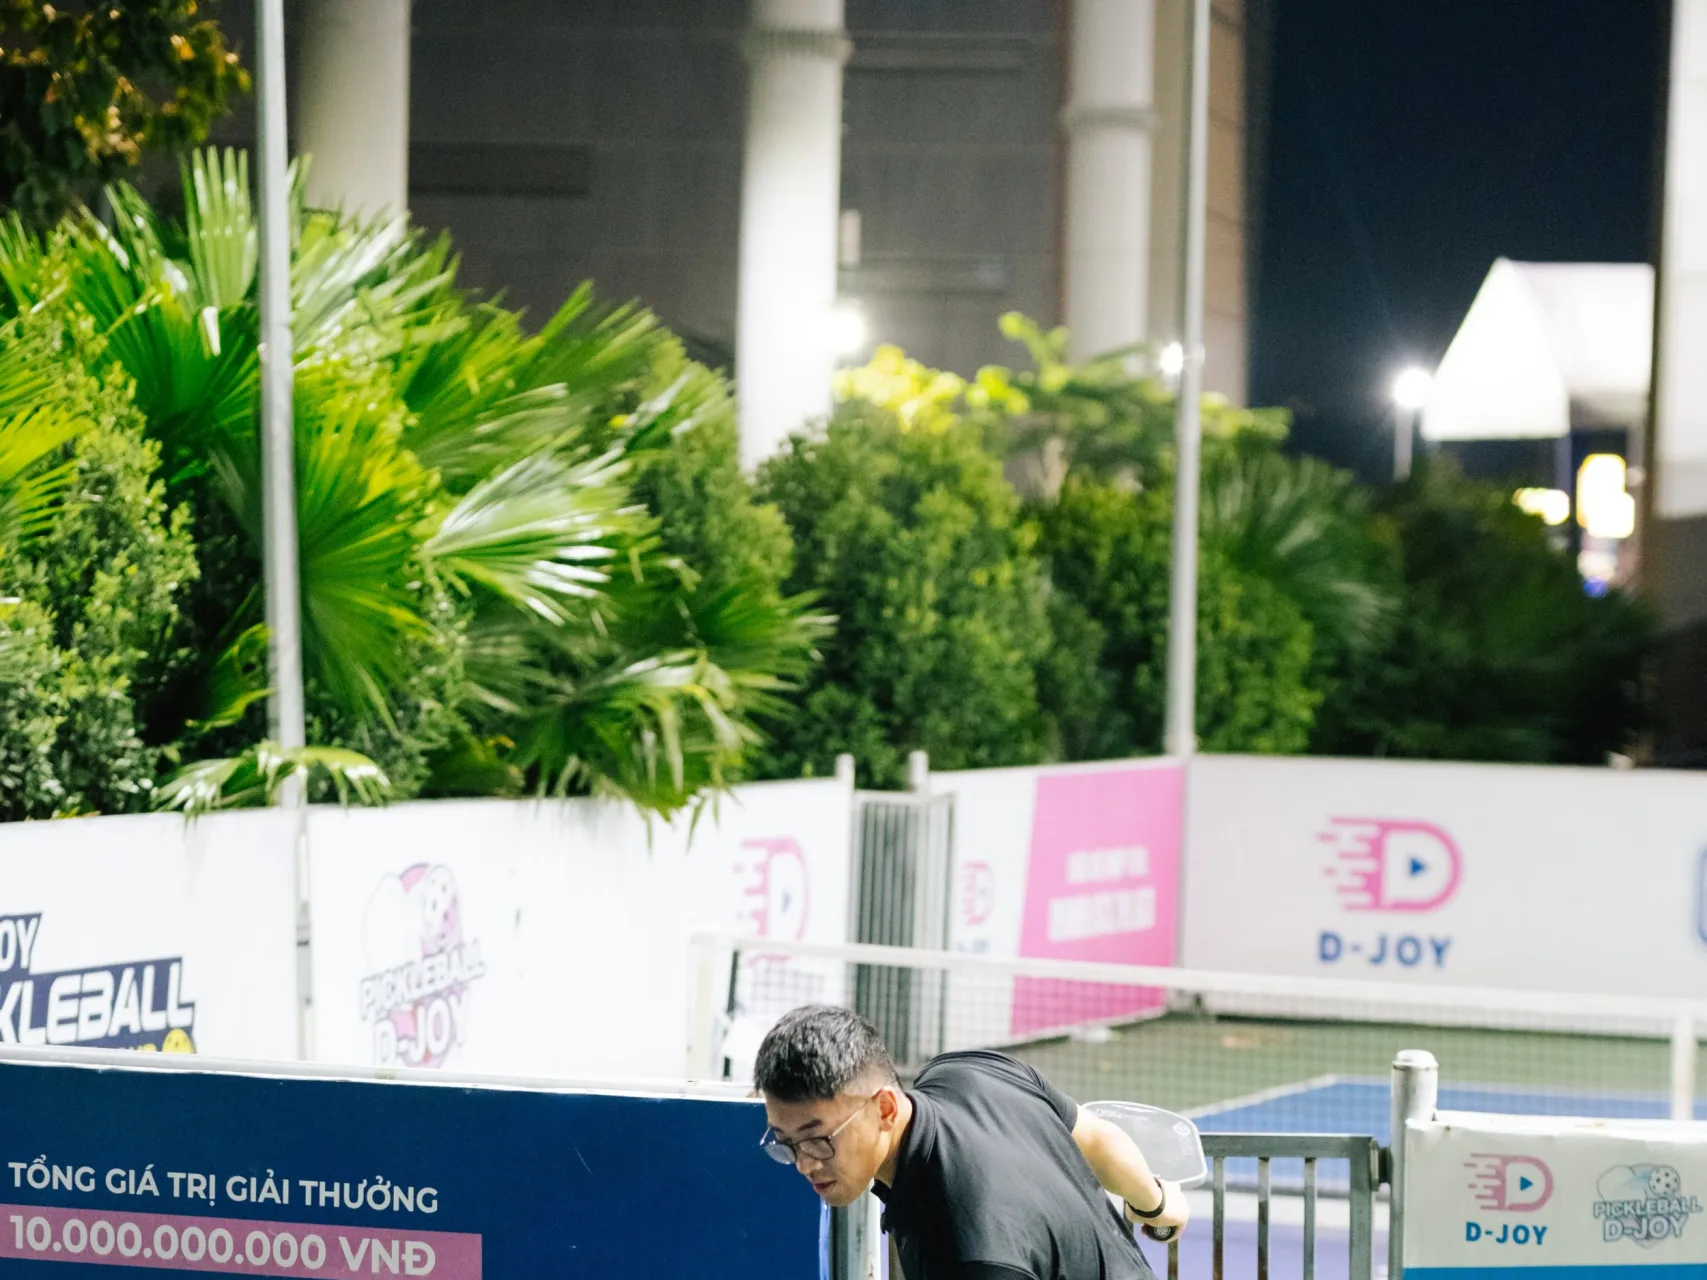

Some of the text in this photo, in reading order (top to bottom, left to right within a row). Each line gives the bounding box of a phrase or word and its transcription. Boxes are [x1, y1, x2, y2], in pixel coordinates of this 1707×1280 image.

[1319, 931, 1454, 969] D-JOY
[8, 1154, 439, 1213] TỔNG GIÁ TRỊ GIẢI THƯỞNG
[1593, 1196, 1704, 1219] PICKLEBALL
[1465, 1221, 1548, 1246] D-JOY
[1603, 1212, 1689, 1243] D-JOY
[9, 1215, 437, 1276] 10.000.000.000 VNĐ
